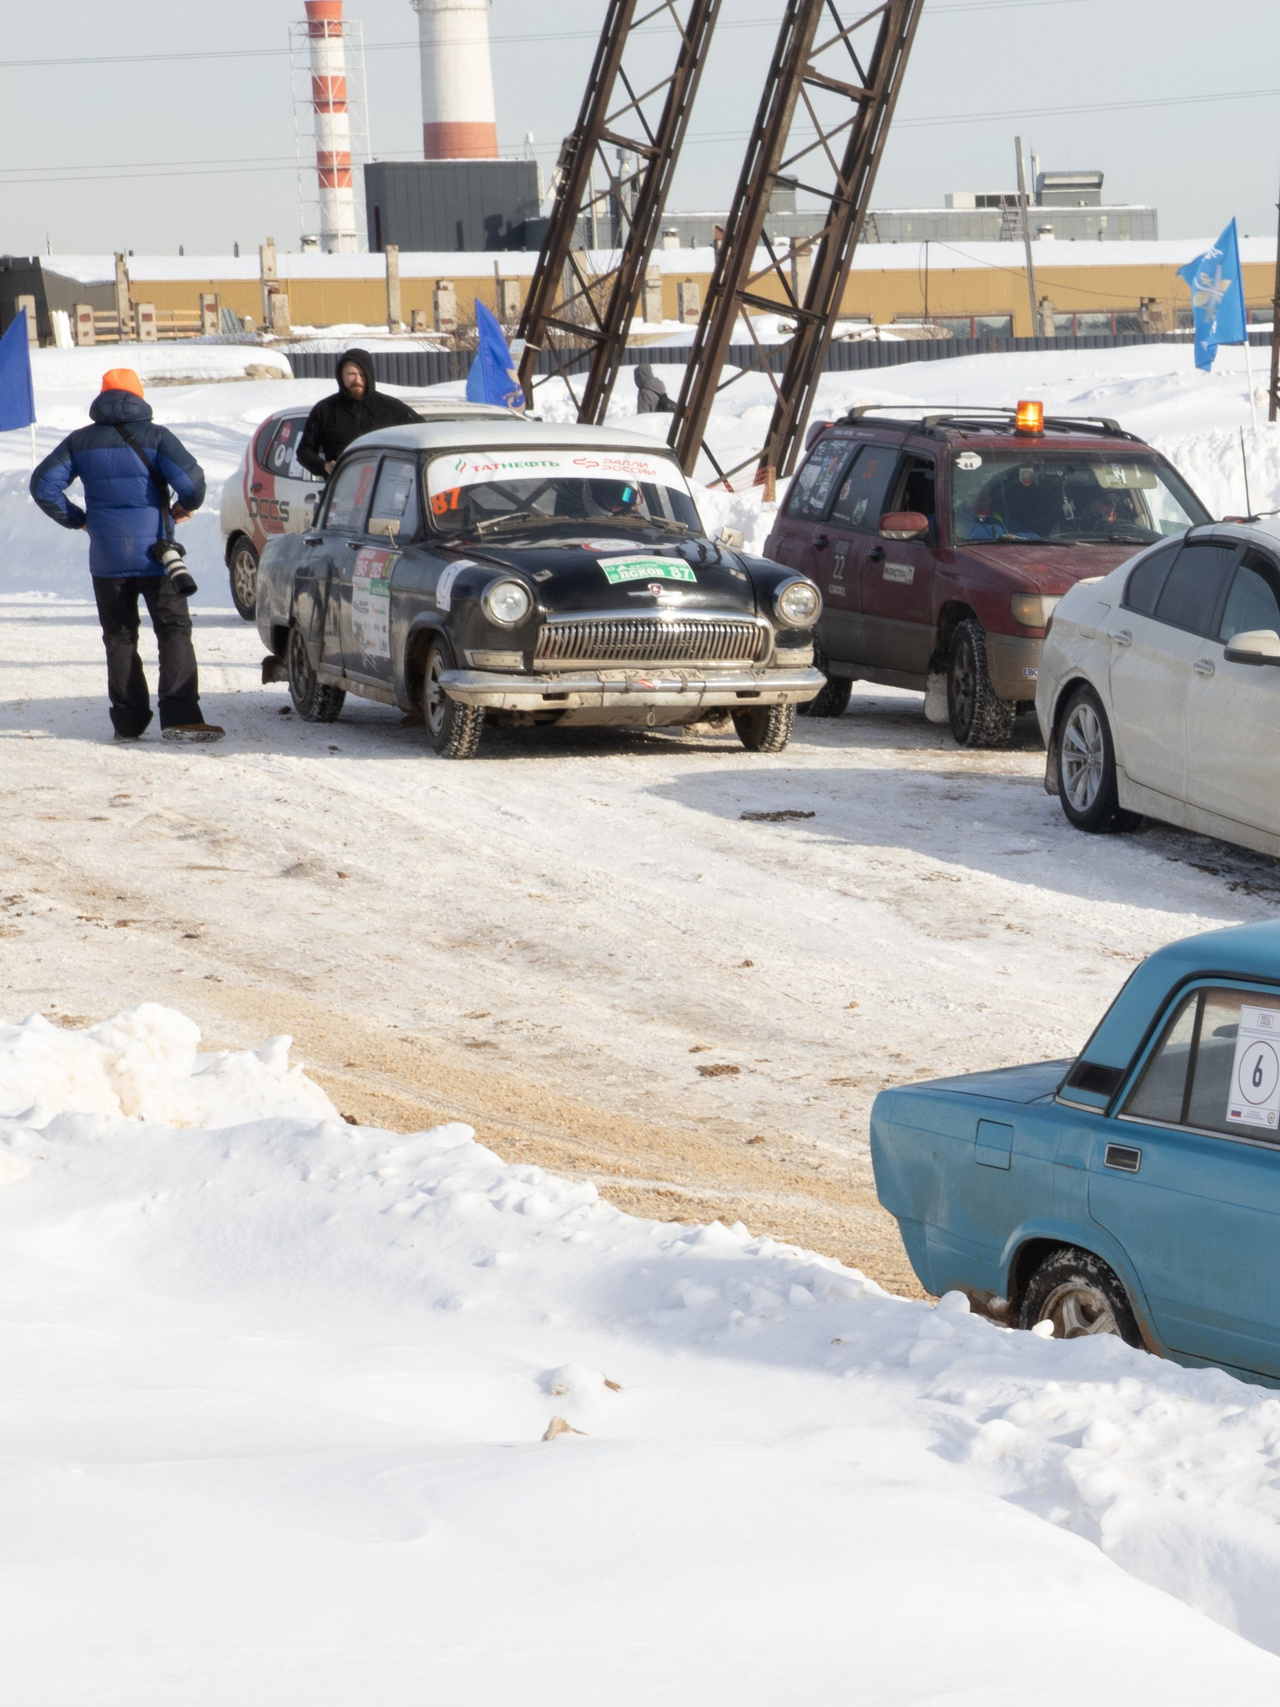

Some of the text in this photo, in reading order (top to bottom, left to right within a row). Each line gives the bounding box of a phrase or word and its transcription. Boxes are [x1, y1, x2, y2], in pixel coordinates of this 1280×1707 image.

[471, 460, 560, 473] ТАТНЕФТЬ
[249, 496, 290, 522] DCCS
[430, 487, 461, 515] 87
[619, 566, 690, 580] ПСКОВ 87
[1252, 1054, 1264, 1088] 6
